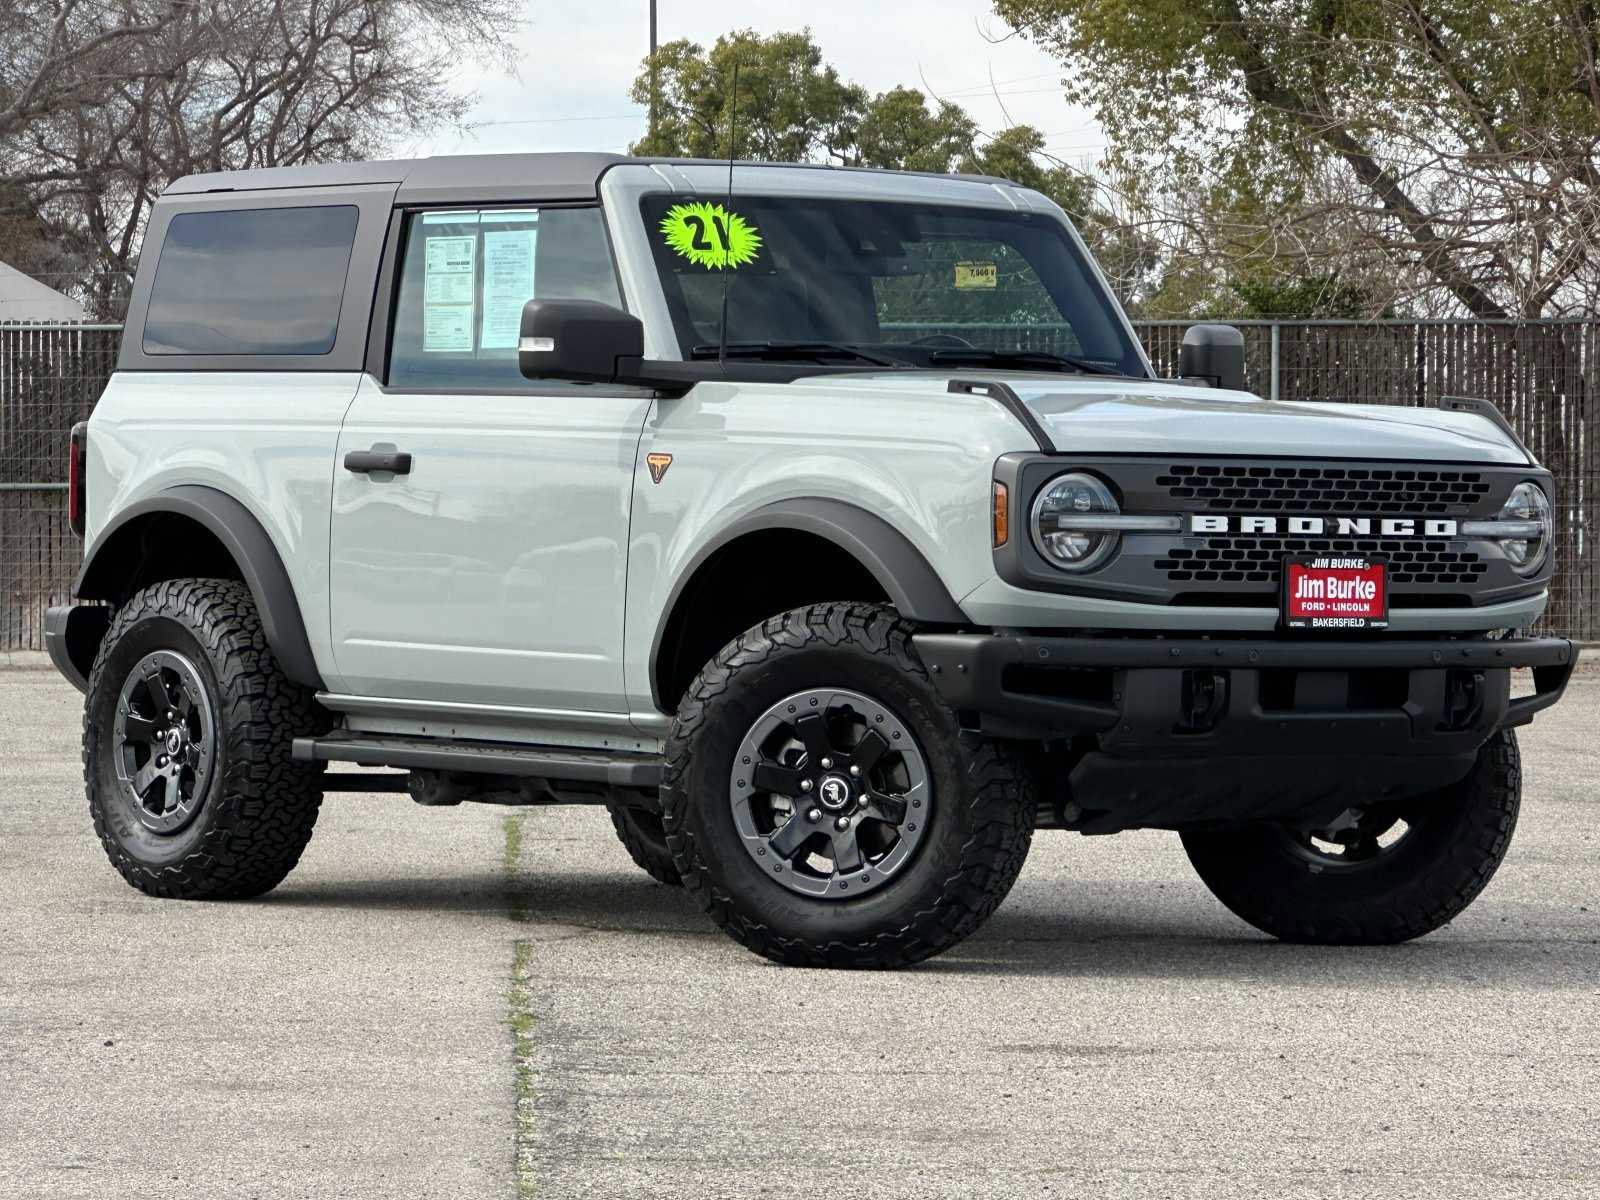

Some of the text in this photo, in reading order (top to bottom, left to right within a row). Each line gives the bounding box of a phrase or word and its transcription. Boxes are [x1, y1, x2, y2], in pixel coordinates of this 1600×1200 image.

[683, 215, 731, 251] 21
[1191, 515, 1457, 536] BRONCO
[1311, 558, 1364, 569] JIM BURKE
[1295, 574, 1377, 600] Jim Burke
[1301, 602, 1370, 612] FORD LINCOLN
[1312, 618, 1365, 627] BAKERSFIELD
